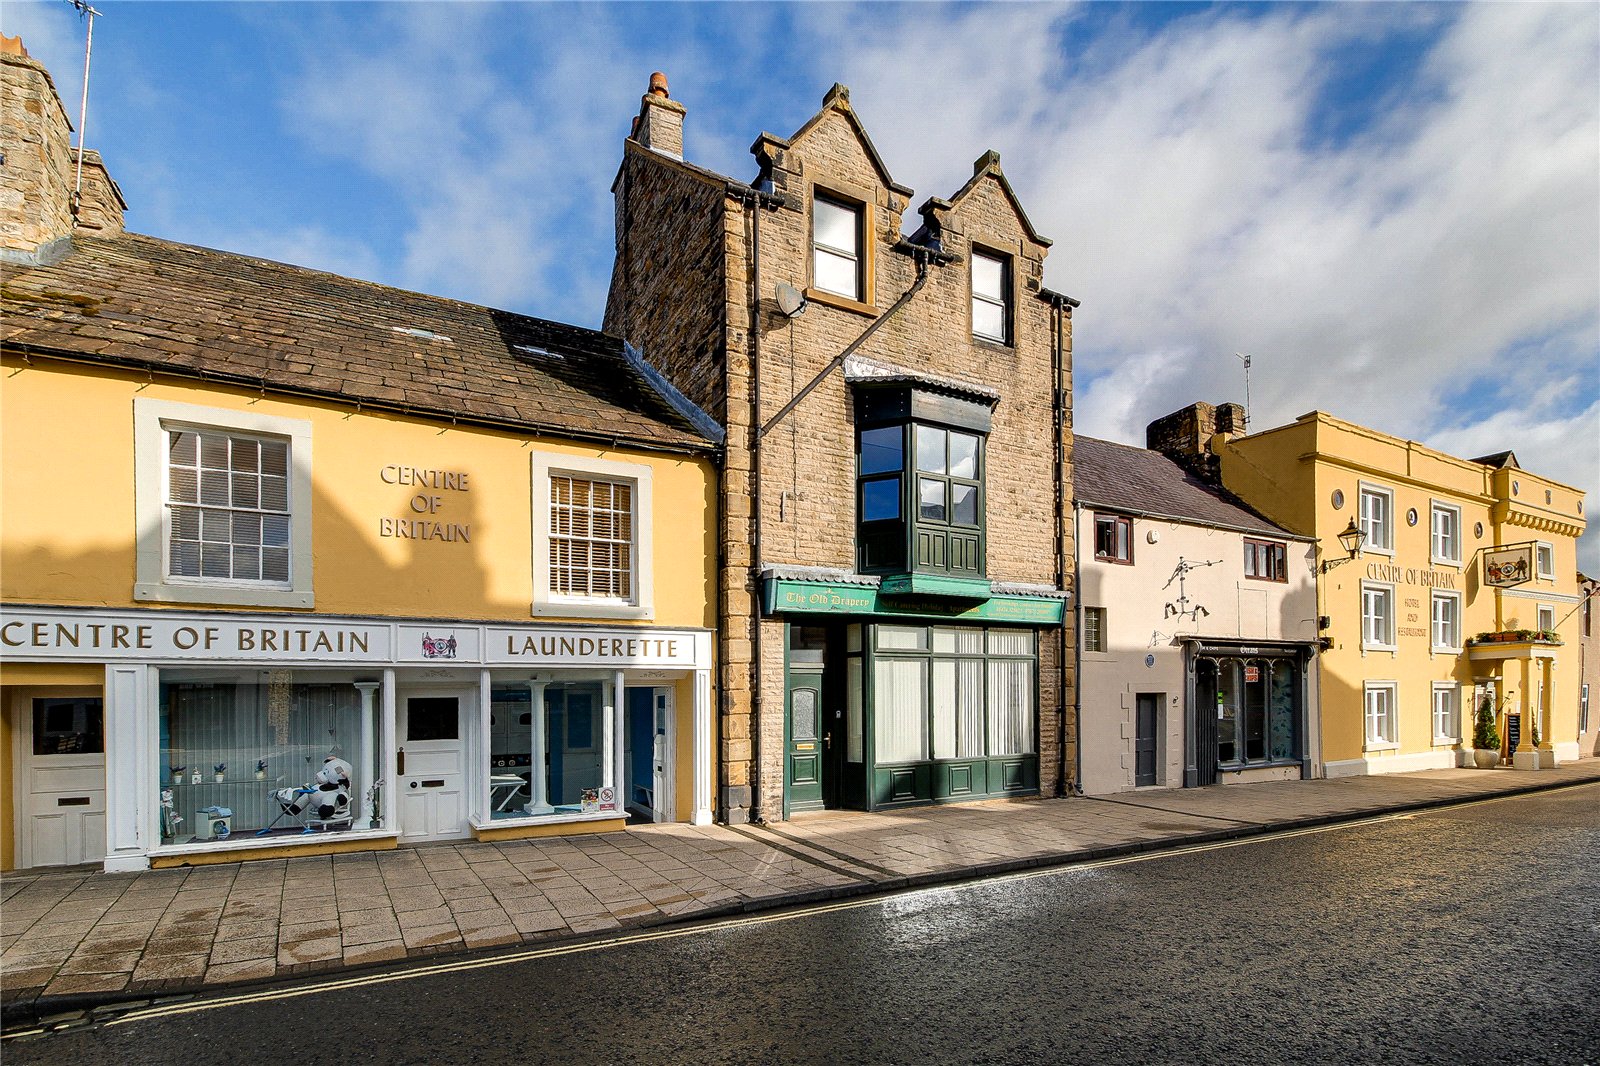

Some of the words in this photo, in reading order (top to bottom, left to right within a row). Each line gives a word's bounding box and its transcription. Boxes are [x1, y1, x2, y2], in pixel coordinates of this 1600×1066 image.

[380, 464, 470, 492] CENTRE
[410, 493, 442, 515] OF
[380, 517, 470, 543] BRITAIN
[1366, 562, 1403, 584] CENTRE
[1405, 567, 1419, 586] OF
[1420, 569, 1455, 589] BRITAIN
[786, 592, 806, 604] The
[809, 593, 828, 605] Old
[831, 594, 870, 608] Drapery
[0, 621, 152, 649] CENTRE
[172, 626, 219, 650] OF
[237, 628, 368, 653] BRITAIN
[507, 635, 677, 657] LAUNDERETTE
